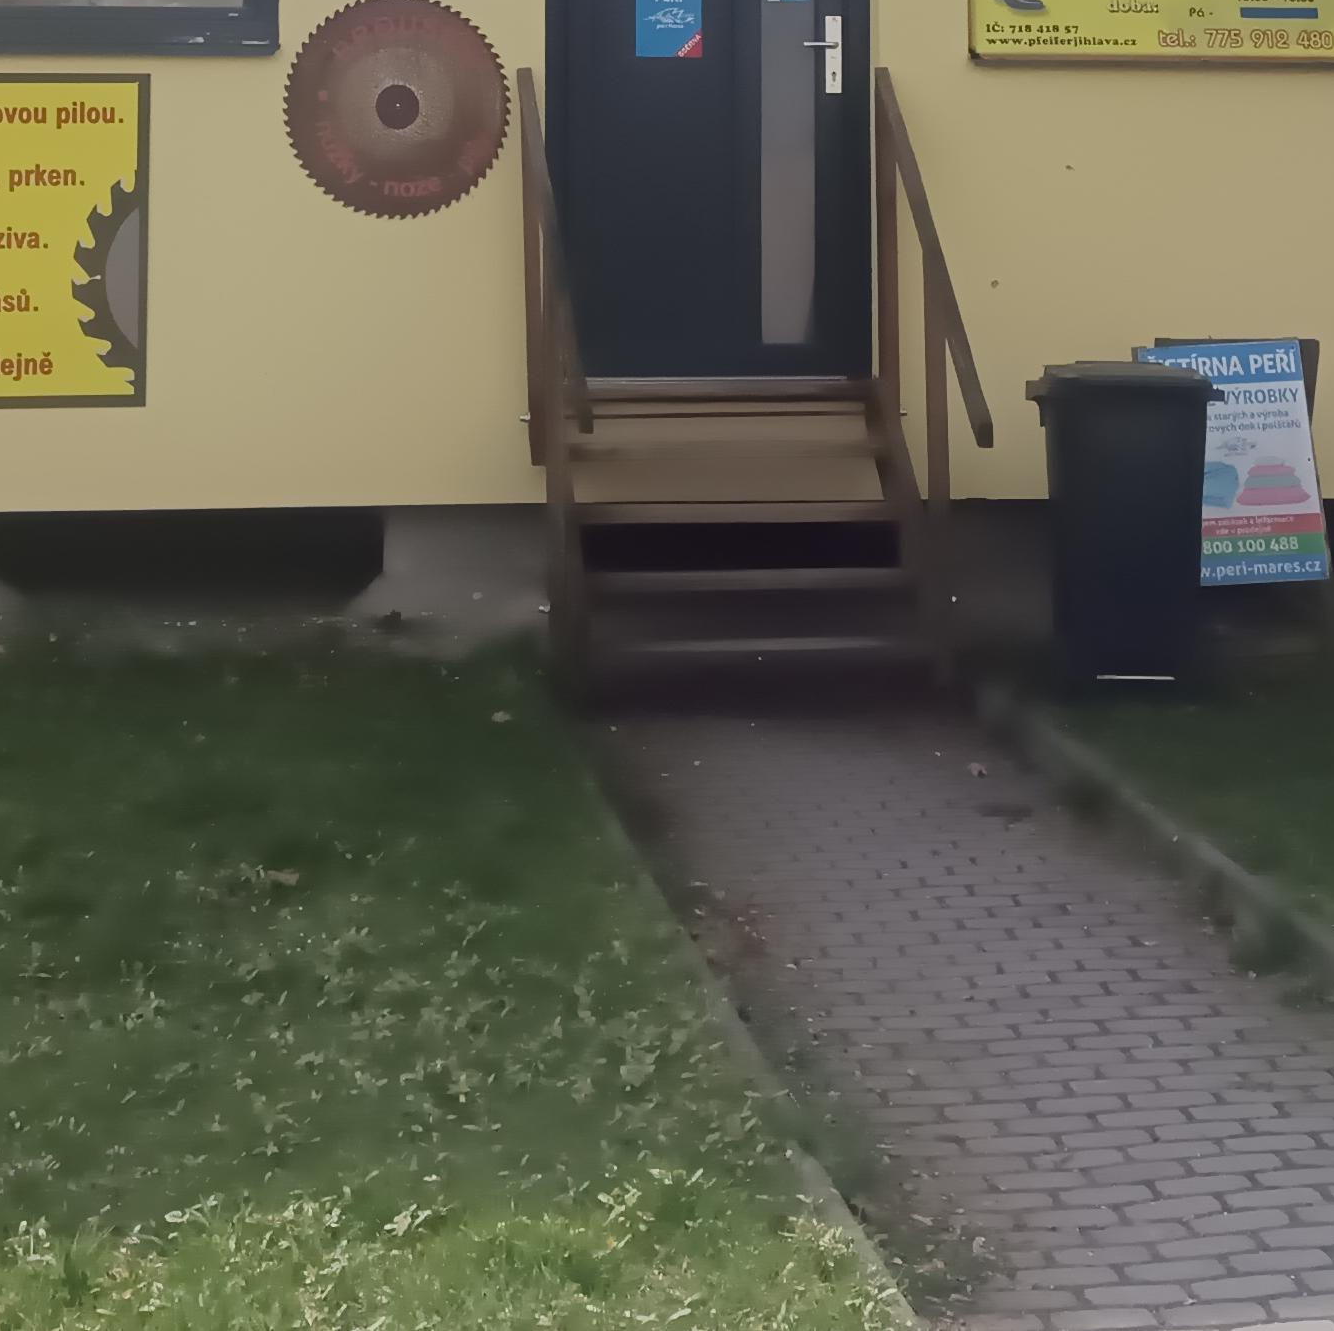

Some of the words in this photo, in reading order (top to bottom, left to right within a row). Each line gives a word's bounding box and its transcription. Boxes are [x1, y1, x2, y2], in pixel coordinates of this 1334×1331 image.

[1107, 0, 1159, 13] doba:
[1189, 7, 1204, 18] Pá
[986, 22, 1005, 33] IČ:
[1009, 25, 1032, 34] 718
[1037, 25, 1059, 33] 418
[1064, 25, 1079, 34] 57
[1158, 28, 1196, 48] tel.:
[1204, 28, 1243, 48] 775
[1250, 29, 1290, 49] 912
[1296, 30, 1334, 49] 480
[56, 102, 125, 128] pilou.
[8, 164, 85, 191] prken.
[1147, 353, 1244, 377] TÍRNA
[1249, 348, 1296, 374] PEŘÍ
[1203, 541, 1232, 555] 800
[1237, 539, 1266, 553] 100
[1270, 536, 1299, 552] 488
[1201, 560, 1322, 581] w.peri-mares.cz
